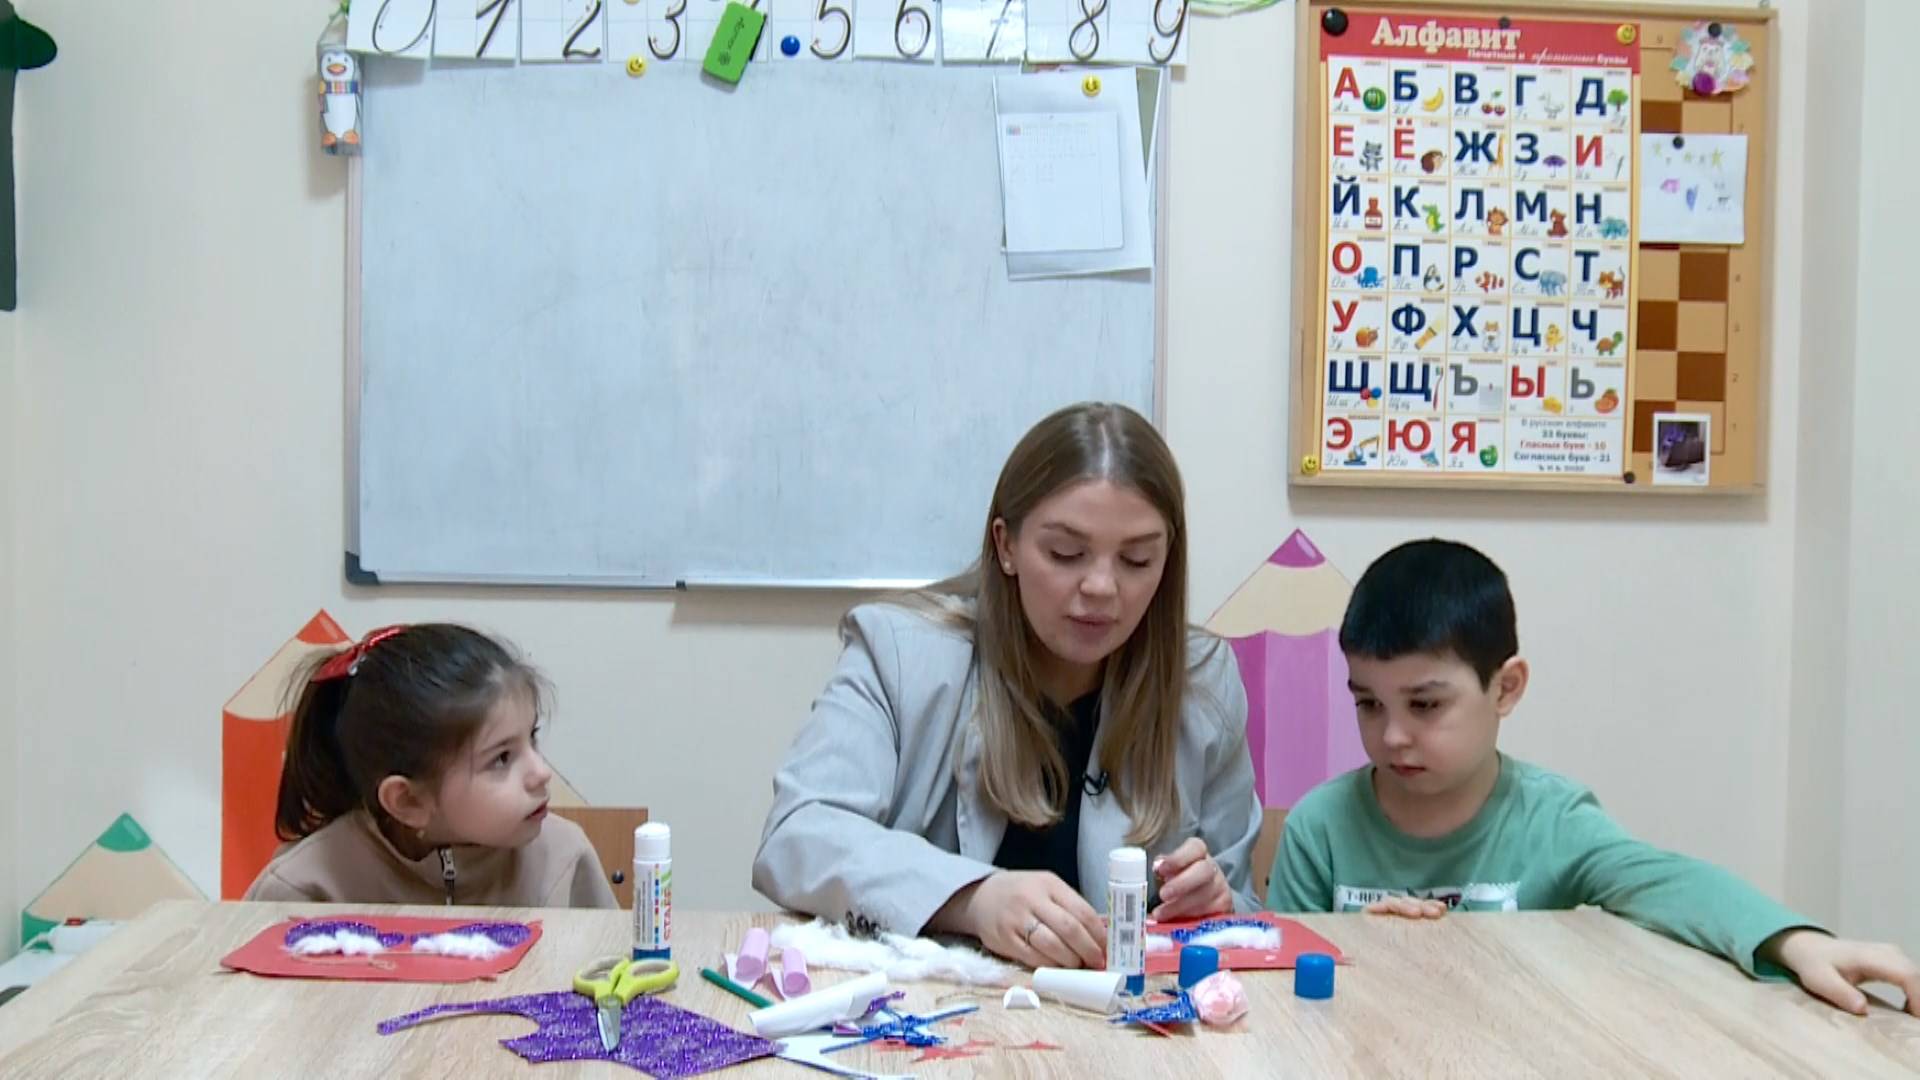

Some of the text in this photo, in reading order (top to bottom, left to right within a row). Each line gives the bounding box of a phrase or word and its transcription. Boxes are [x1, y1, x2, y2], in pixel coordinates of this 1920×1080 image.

[372, 0, 436, 54] 0
[476, 0, 511, 58] 1
[563, 0, 601, 58] 2
[647, 0, 687, 60] 3
[810, 0, 851, 59] 5
[894, 0, 931, 58] 6
[1068, 0, 1104, 61] 8
[1148, 0, 1188, 63] 9
[1371, 17, 1521, 54] Алфавит
[1468, 49, 1517, 60] Печатные
[1518, 51, 1525, 60] и
[1597, 54, 1628, 66] буквы
[1335, 68, 1606, 116] А Б В Г Д
[1334, 120, 1601, 166] Е Ё Ж З И
[1334, 176, 1601, 224] Й К Л М Н
[1333, 242, 1599, 282] О П Р С Т
[1333, 301, 1597, 347] У Ф Х Ц Ч
[1329, 360, 1594, 402] Ш Щ Ъ Ы Ь
[1327, 417, 1475, 452] Э Ю Я
[1520, 440, 1560, 449] Гласных
[1563, 441, 1585, 450] букв
[1594, 441, 1607, 450] 10
[1542, 430, 1554, 438] 33
[1514, 451, 1565, 461] Согласных
[1568, 452, 1590, 462] букв
[1599, 454, 1611, 462] 21
